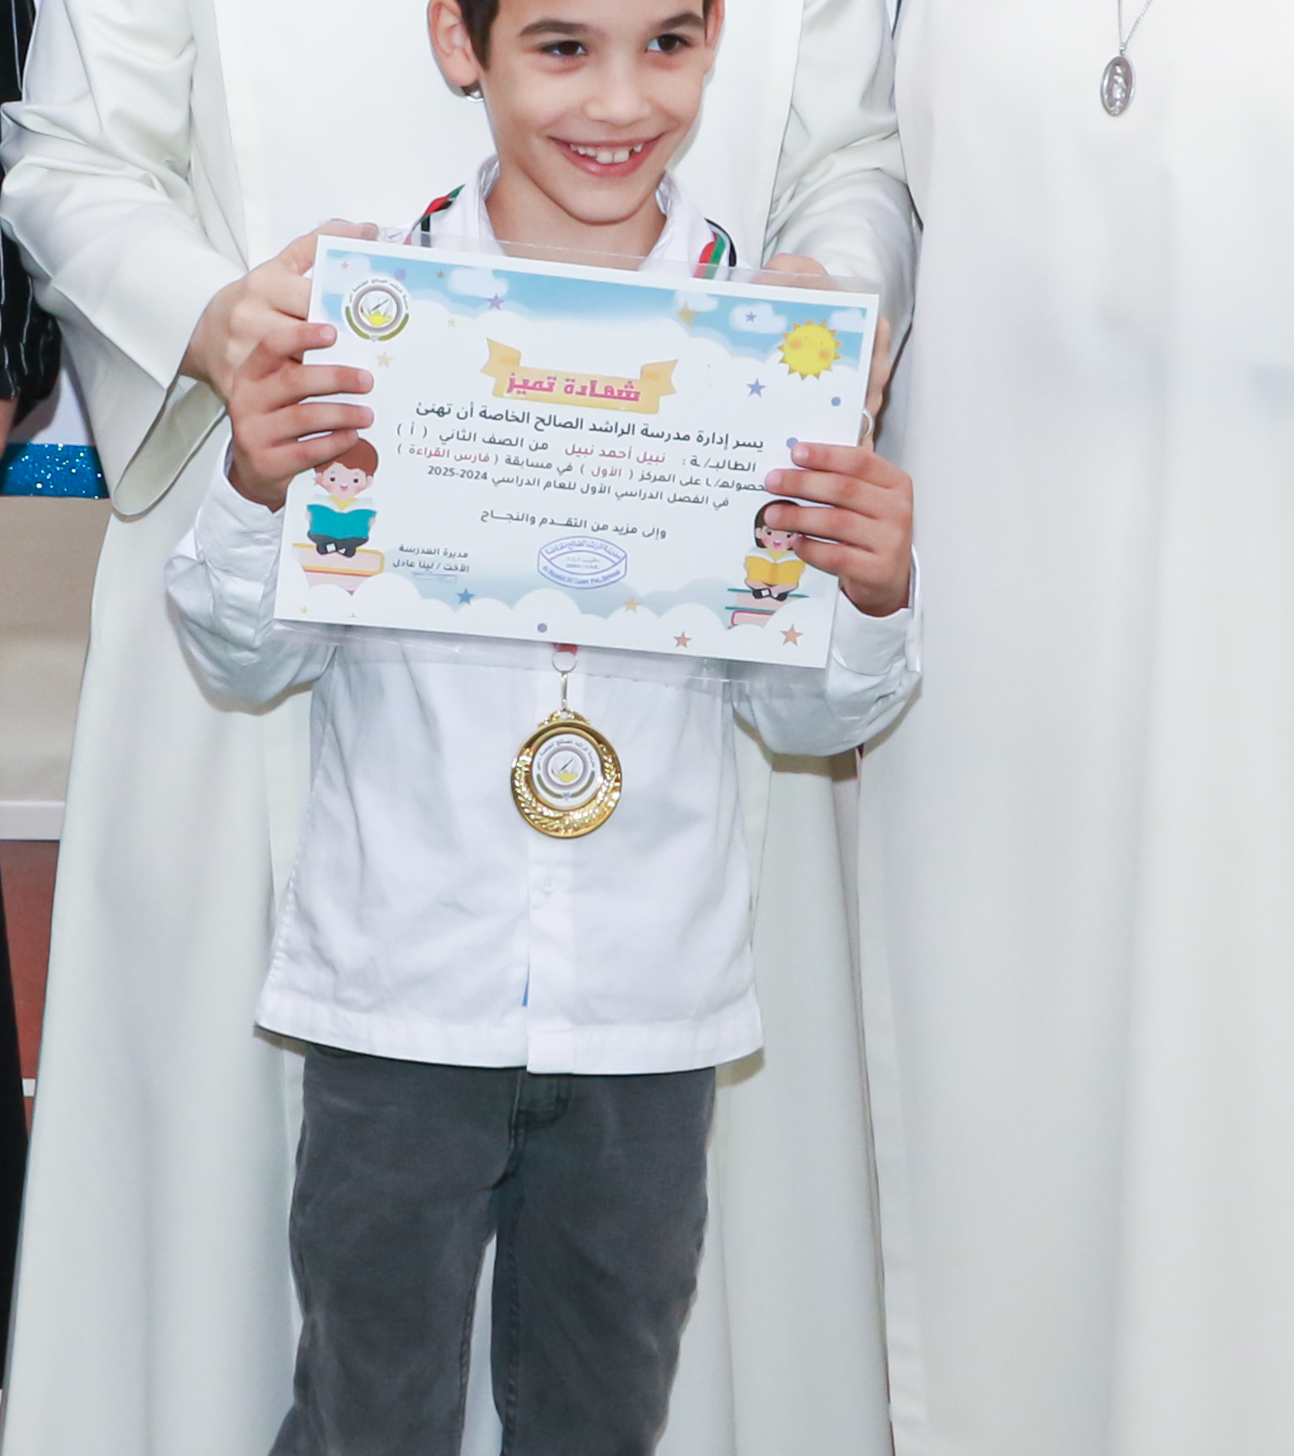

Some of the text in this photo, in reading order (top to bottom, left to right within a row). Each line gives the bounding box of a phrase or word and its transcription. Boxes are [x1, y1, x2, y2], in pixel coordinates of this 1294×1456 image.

[506, 371, 641, 403] شهادة تميز
[456, 401, 475, 421] أن
[479, 405, 531, 427] الخاصة
[534, 412, 584, 432] الصالح
[588, 418, 636, 437] الراشد
[438, 427, 477, 446] الثاني
[481, 433, 524, 448] الصف
[641, 425, 691, 444] مدرسة
[696, 430, 729, 450] إدارة
[408, 444, 450, 459] القراءة
[528, 440, 549, 452] من
[564, 444, 595, 458] نبيل
[598, 445, 633, 460] أحمد
[732, 440, 764, 453] يسر
[453, 451, 490, 464] فارس
[504, 454, 553, 470] مسابقة
[636, 451, 666, 465] نبيل
[556, 461, 573, 476] في
[591, 465, 622, 478] الأول
[491, 473, 541, 488] الدراسي
[638, 470, 677, 484] المركز
[679, 475, 701, 487] على
[542, 478, 577, 492] للعام
[580, 482, 611, 496] الأول
[614, 486, 664, 502] الدراسي
[667, 492, 709, 505] الفصل
[712, 496, 729, 512] في
[591, 520, 609, 533] من
[612, 522, 638, 536] مزيد
[641, 525, 667, 540] وإلى
[398, 543, 469, 559] مديرة المدرسة
[392, 557, 470, 573] الأخت لينا عادل
